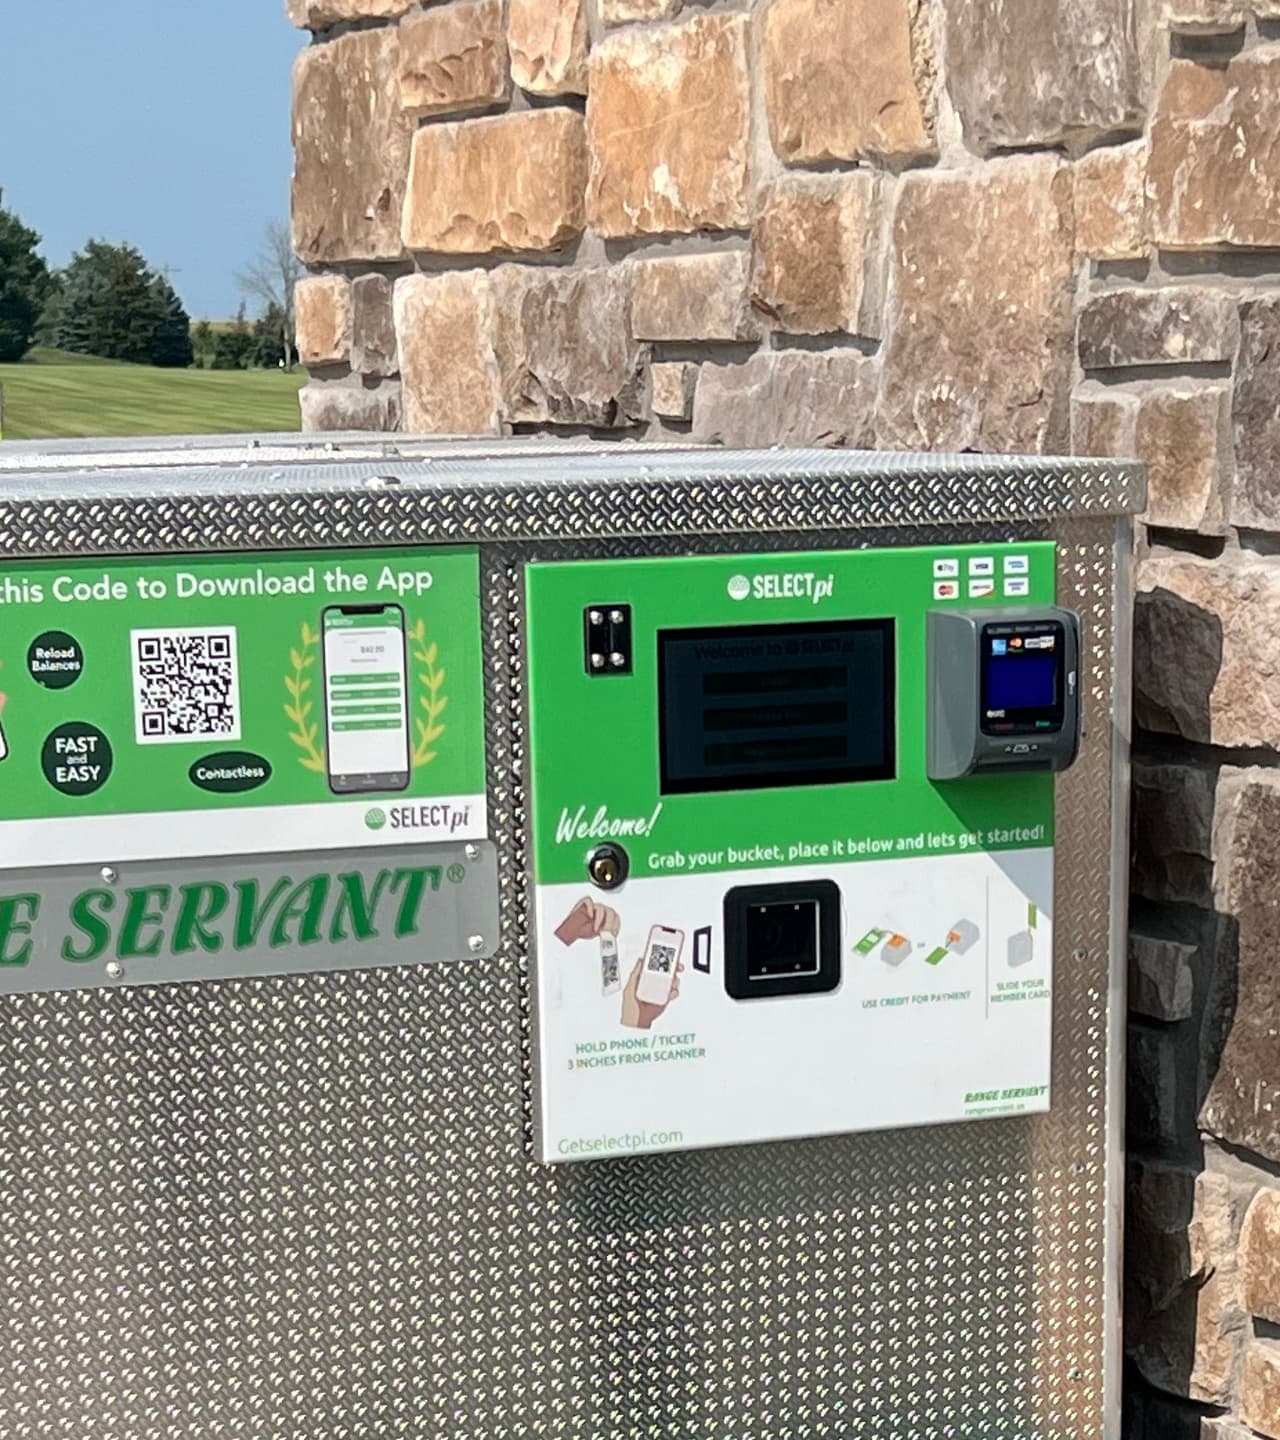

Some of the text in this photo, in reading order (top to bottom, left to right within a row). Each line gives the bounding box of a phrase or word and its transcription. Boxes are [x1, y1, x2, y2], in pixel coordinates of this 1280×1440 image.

[52, 574, 128, 601] Code
[136, 577, 167, 599] to
[176, 567, 315, 598] Download
[323, 566, 369, 592] the
[376, 566, 433, 596] App
[752, 572, 834, 604] SELECTpi
[35, 646, 75, 659] Reload
[32, 660, 80, 672] Balances
[55, 736, 98, 753] FAST
[66, 753, 88, 765] and
[55, 765, 100, 783] EASY
[196, 765, 265, 780] Contactless
[390, 805, 470, 833] SELECTpi
[555, 802, 662, 844] Welcome!
[648, 824, 1045, 870] Grab your bucket, place it below and lets get started!
[1021, 979, 1045, 989] YOUR
[862, 990, 971, 1009] USE CREDIT FOR PAYMENT
[1028, 990, 1050, 1000] CARD
[575, 1042, 607, 1055] HOLD
[610, 1038, 648, 1050] PHONE
[659, 1033, 696, 1046] TICKET
[567, 1048, 706, 1070] 3 INCHES FROM SCANNER
[558, 1129, 683, 1155] Getselectpi.com
